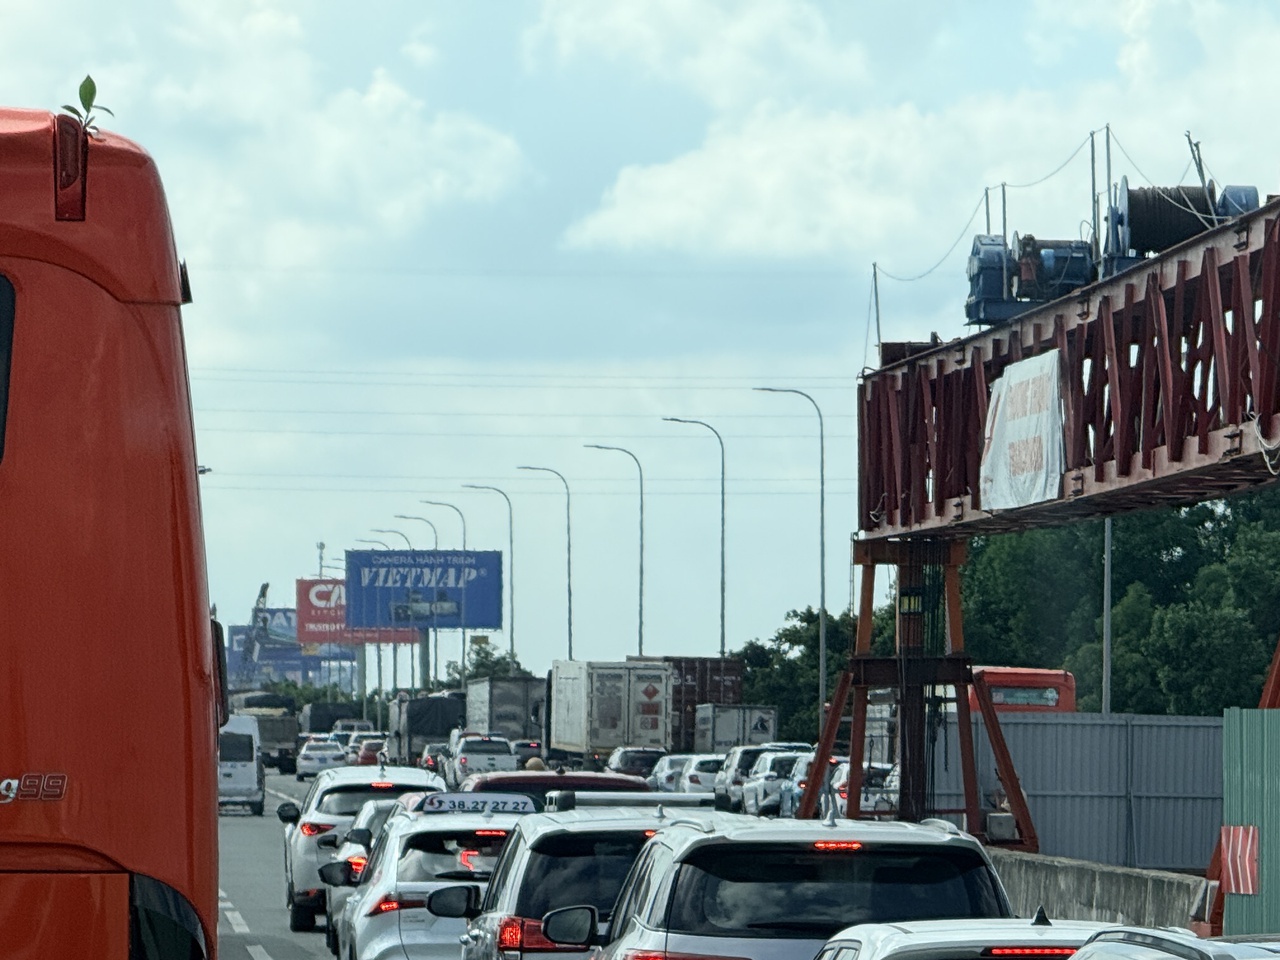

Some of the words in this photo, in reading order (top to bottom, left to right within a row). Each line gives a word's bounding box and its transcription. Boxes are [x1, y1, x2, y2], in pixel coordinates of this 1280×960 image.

[360, 567, 478, 588] VIETMAP
[448, 800, 488, 810] 38.27
[491, 801, 508, 810] 27
[512, 801, 528, 810] 27
